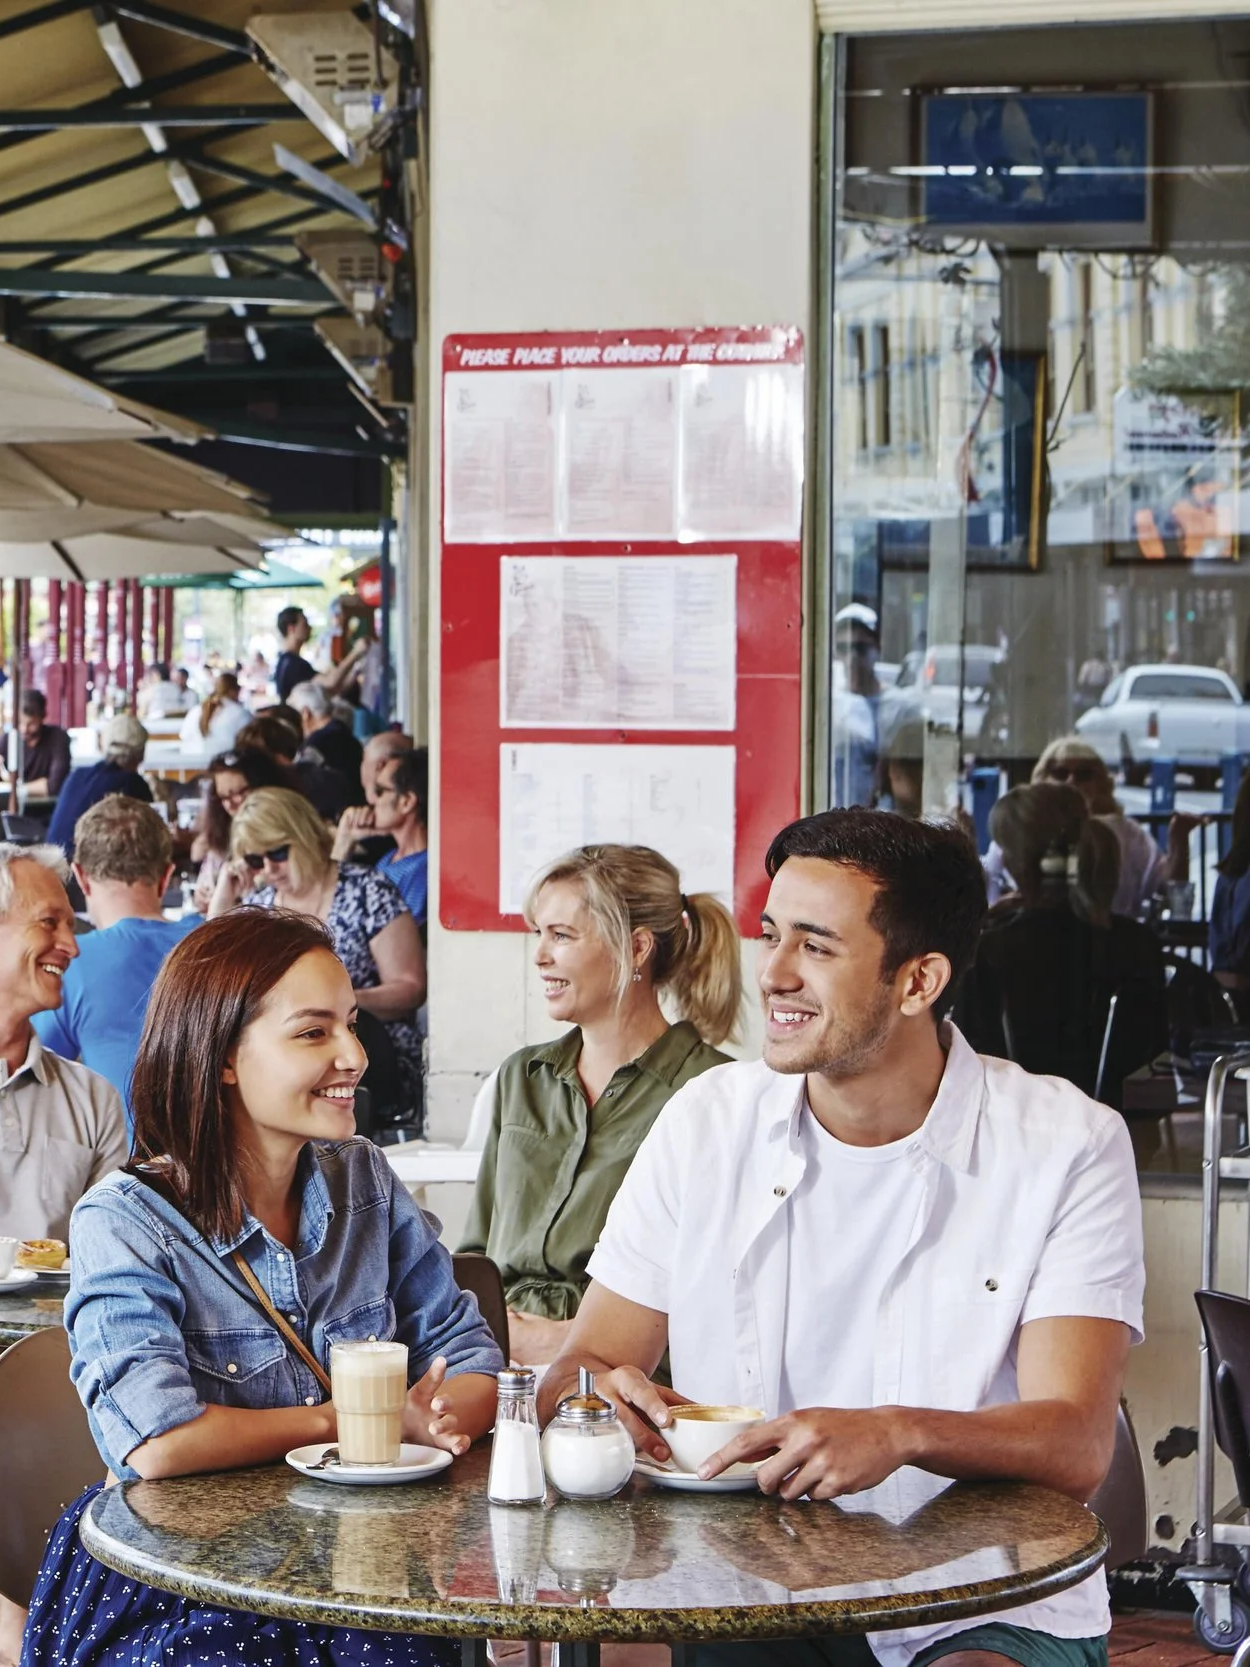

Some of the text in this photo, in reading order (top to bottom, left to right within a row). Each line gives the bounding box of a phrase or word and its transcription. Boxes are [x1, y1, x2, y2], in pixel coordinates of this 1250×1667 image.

[460, 348, 511, 366] PLEASE
[513, 347, 556, 365] PLACE
[561, 346, 600, 364] YOUR
[602, 345, 662, 362] ORDERS
[662, 344, 685, 362] AT
